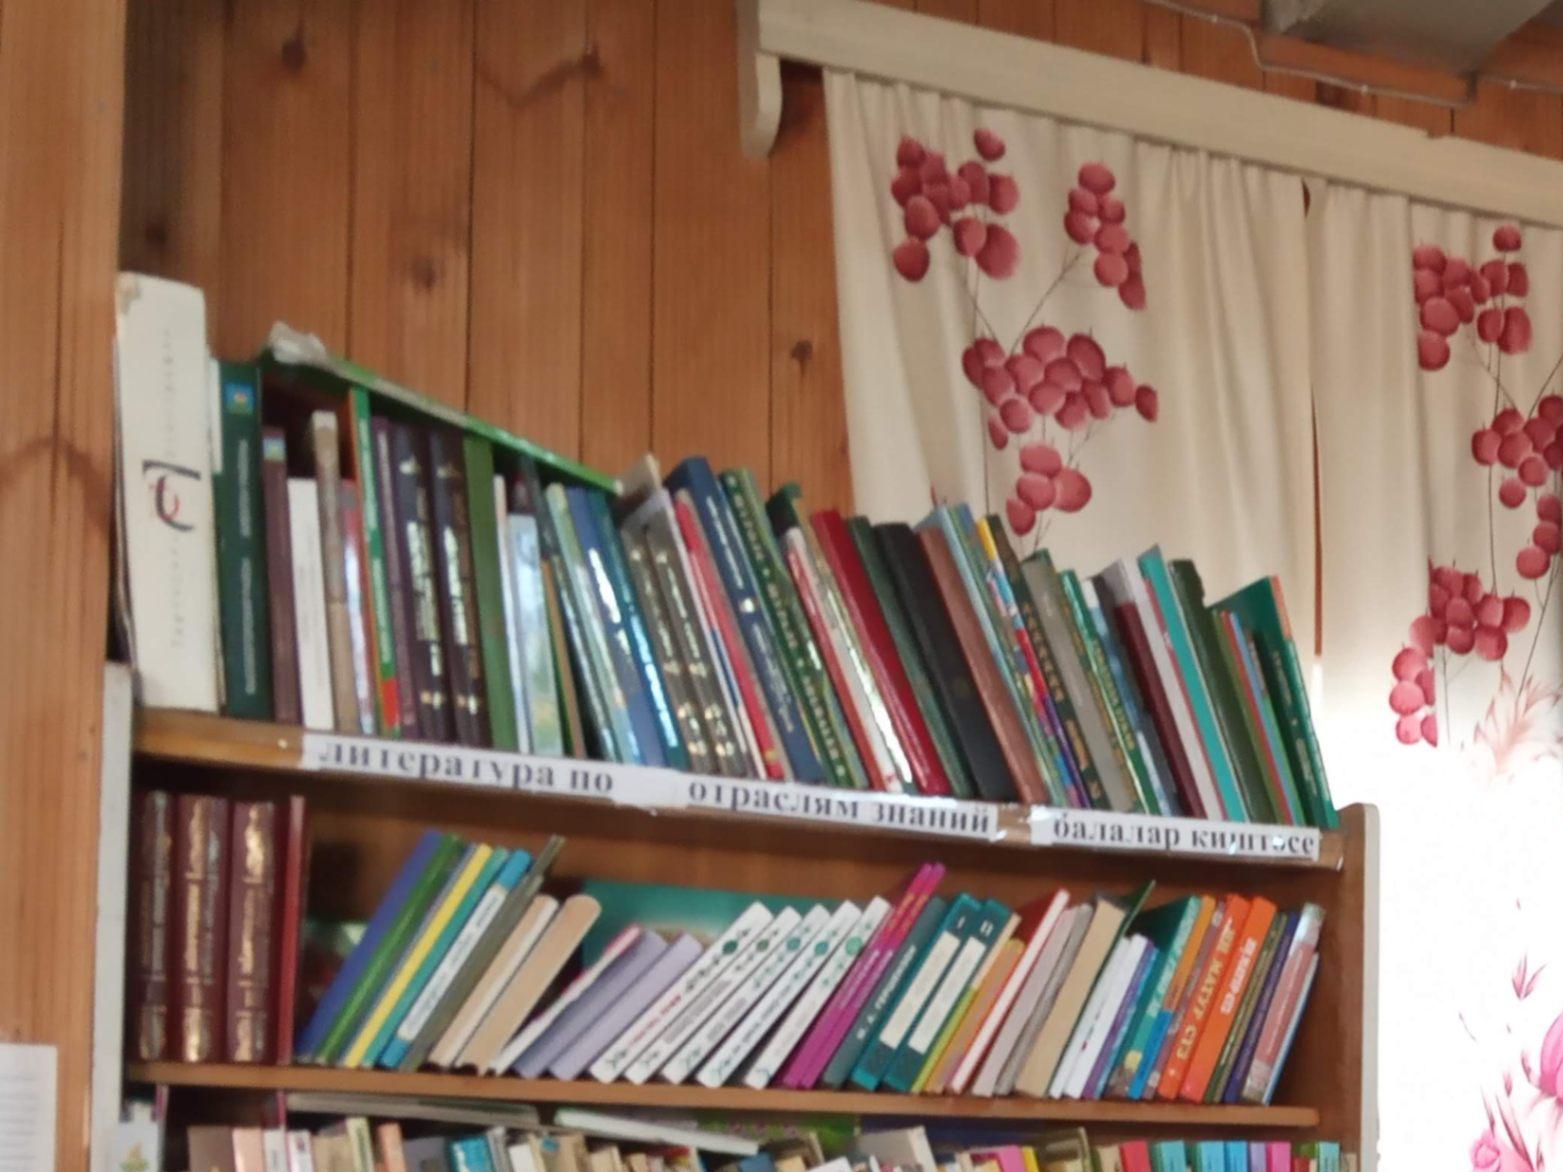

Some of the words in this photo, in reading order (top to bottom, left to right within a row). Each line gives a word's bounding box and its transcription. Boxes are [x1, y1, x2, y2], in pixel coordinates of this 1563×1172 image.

[319, 741, 555, 787] литература
[571, 768, 614, 795] по
[689, 781, 860, 822] отраслям
[874, 799, 989, 833] знаний
[1054, 812, 1180, 851] балалар
